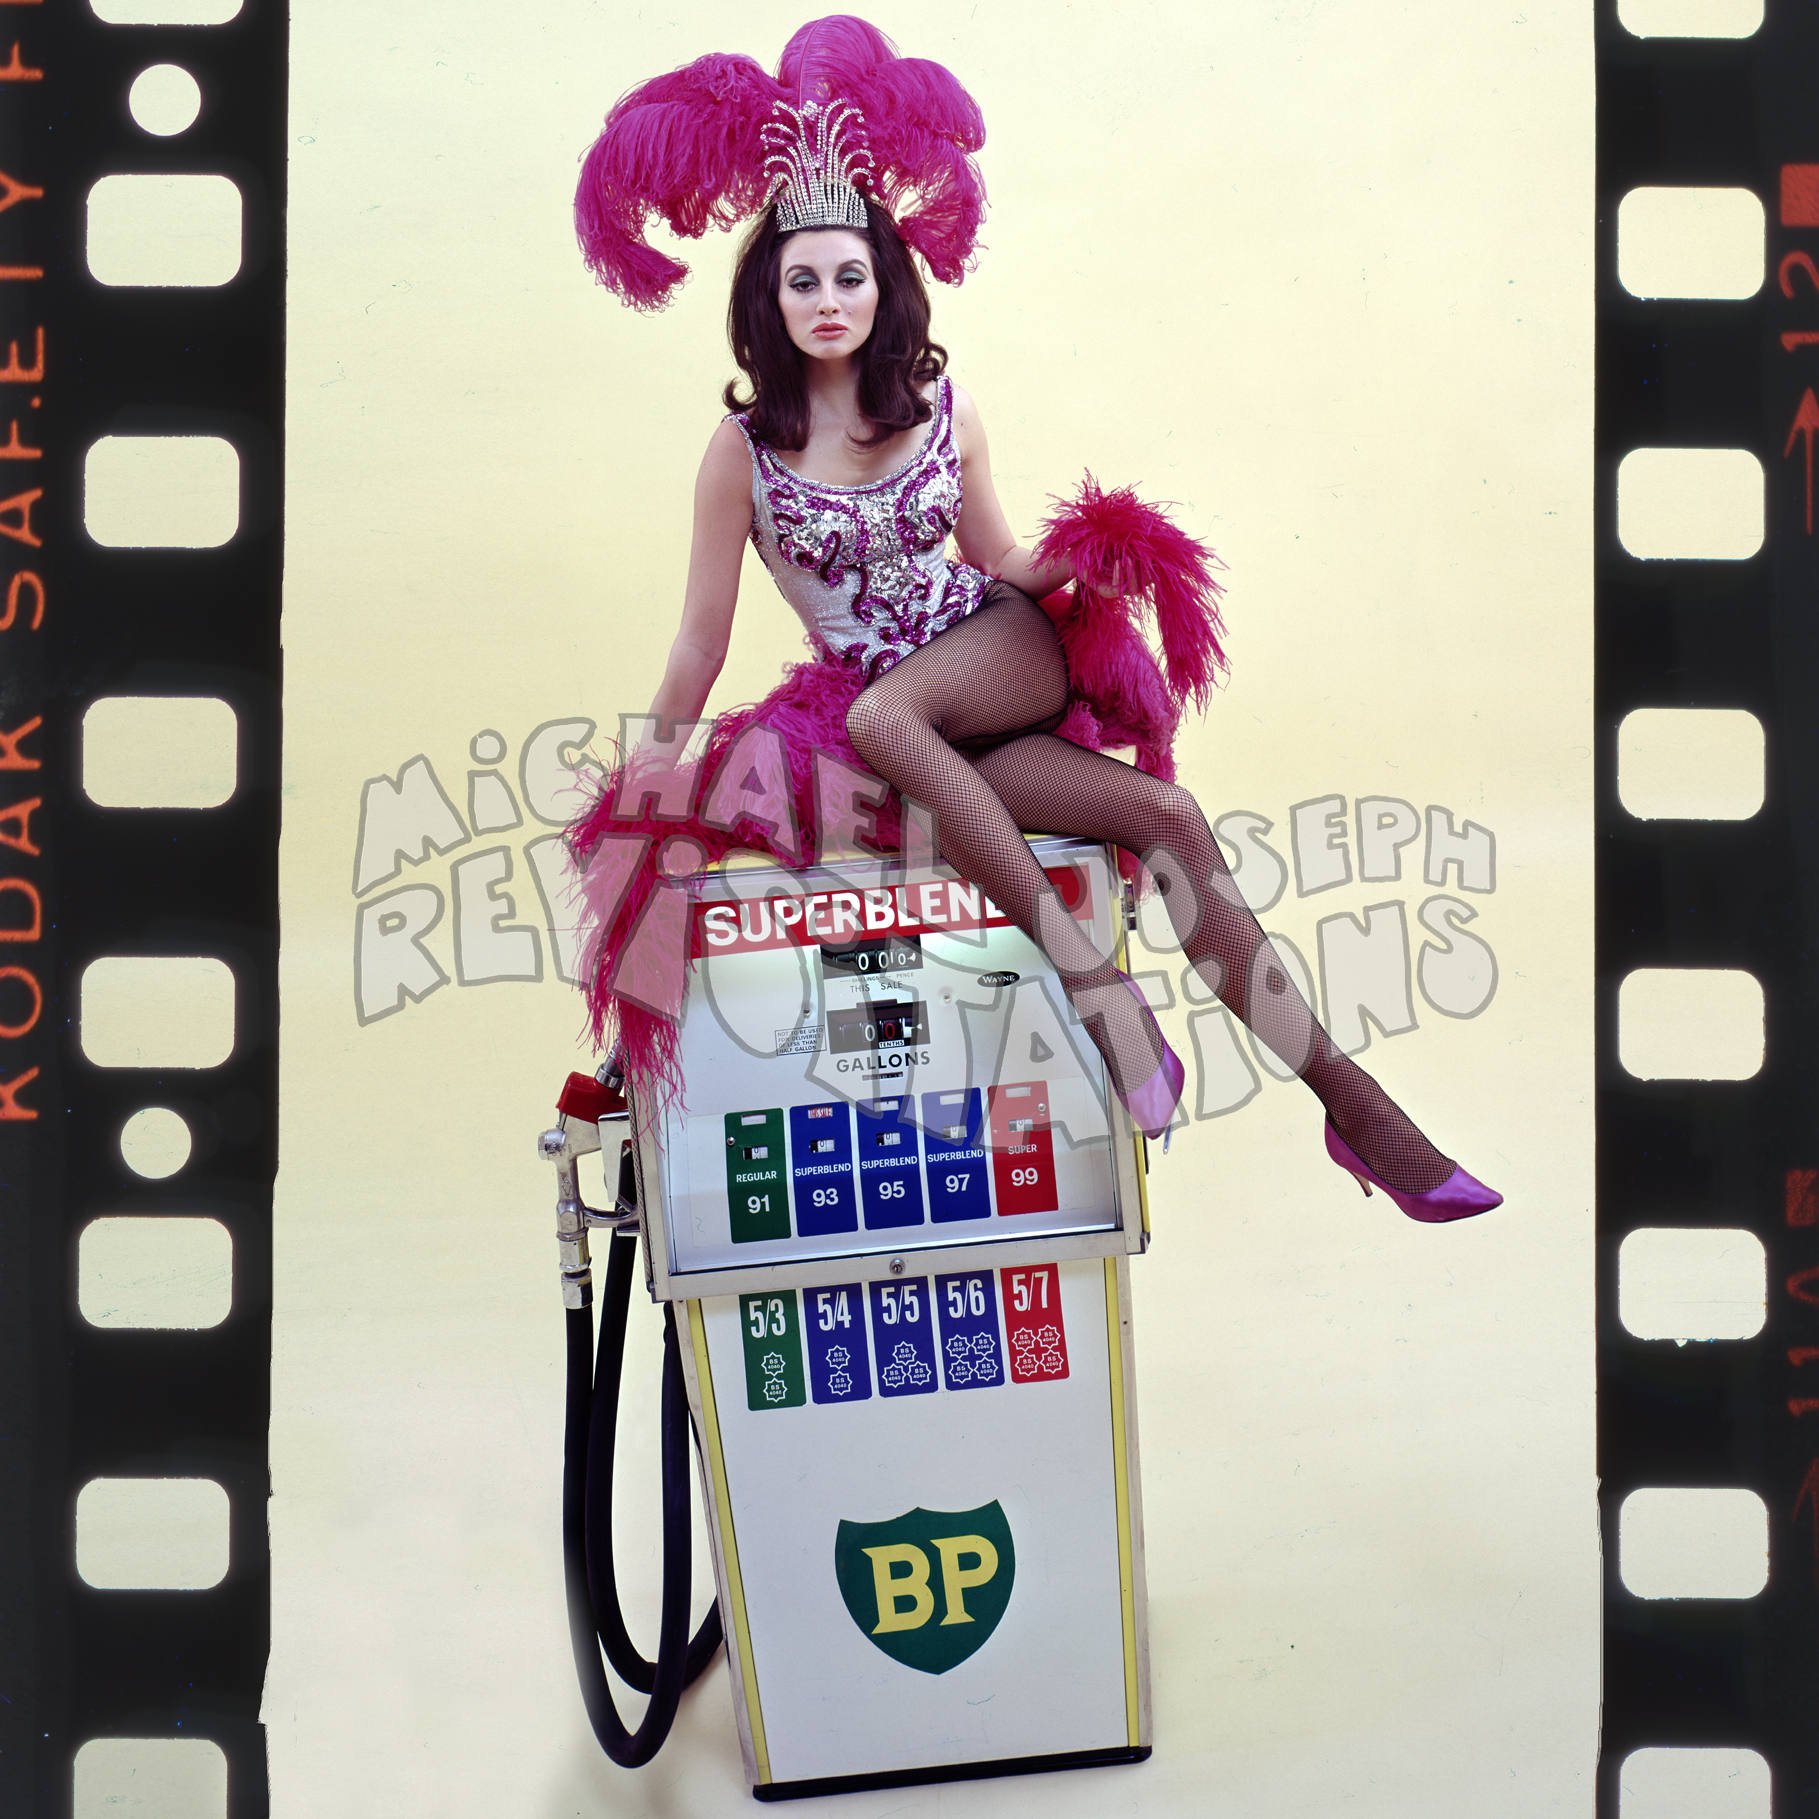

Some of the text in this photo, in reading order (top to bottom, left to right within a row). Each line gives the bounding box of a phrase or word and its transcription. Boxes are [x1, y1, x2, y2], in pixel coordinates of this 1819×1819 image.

[850, 981, 903, 994] THIS SALE
[852, 975, 879, 983] SHILLINGS
[880, 1040, 904, 1048] TENTHS
[836, 1051, 931, 1073] GALLONS
[927, 1149, 984, 1163] SUPERBLEND
[1008, 1143, 1038, 1155] SUPER
[794, 1162, 852, 1177] SUPERBLEND
[861, 1156, 918, 1170] SUPERBLEND
[736, 1170, 778, 1183] REGULAR
[945, 1174, 971, 1193] 97
[1011, 1167, 1039, 1187] 99
[812, 1187, 839, 1208] 93
[879, 1180, 906, 1200] 95
[747, 1194, 770, 1214] 91
[947, 1278, 986, 1319] 5/6
[1012, 1271, 1049, 1312] 5/7
[817, 1291, 852, 1331] 5/4
[881, 1284, 920, 1325] 5/5
[748, 1298, 787, 1339] 5/3
[861, 1534, 999, 1635] BP
